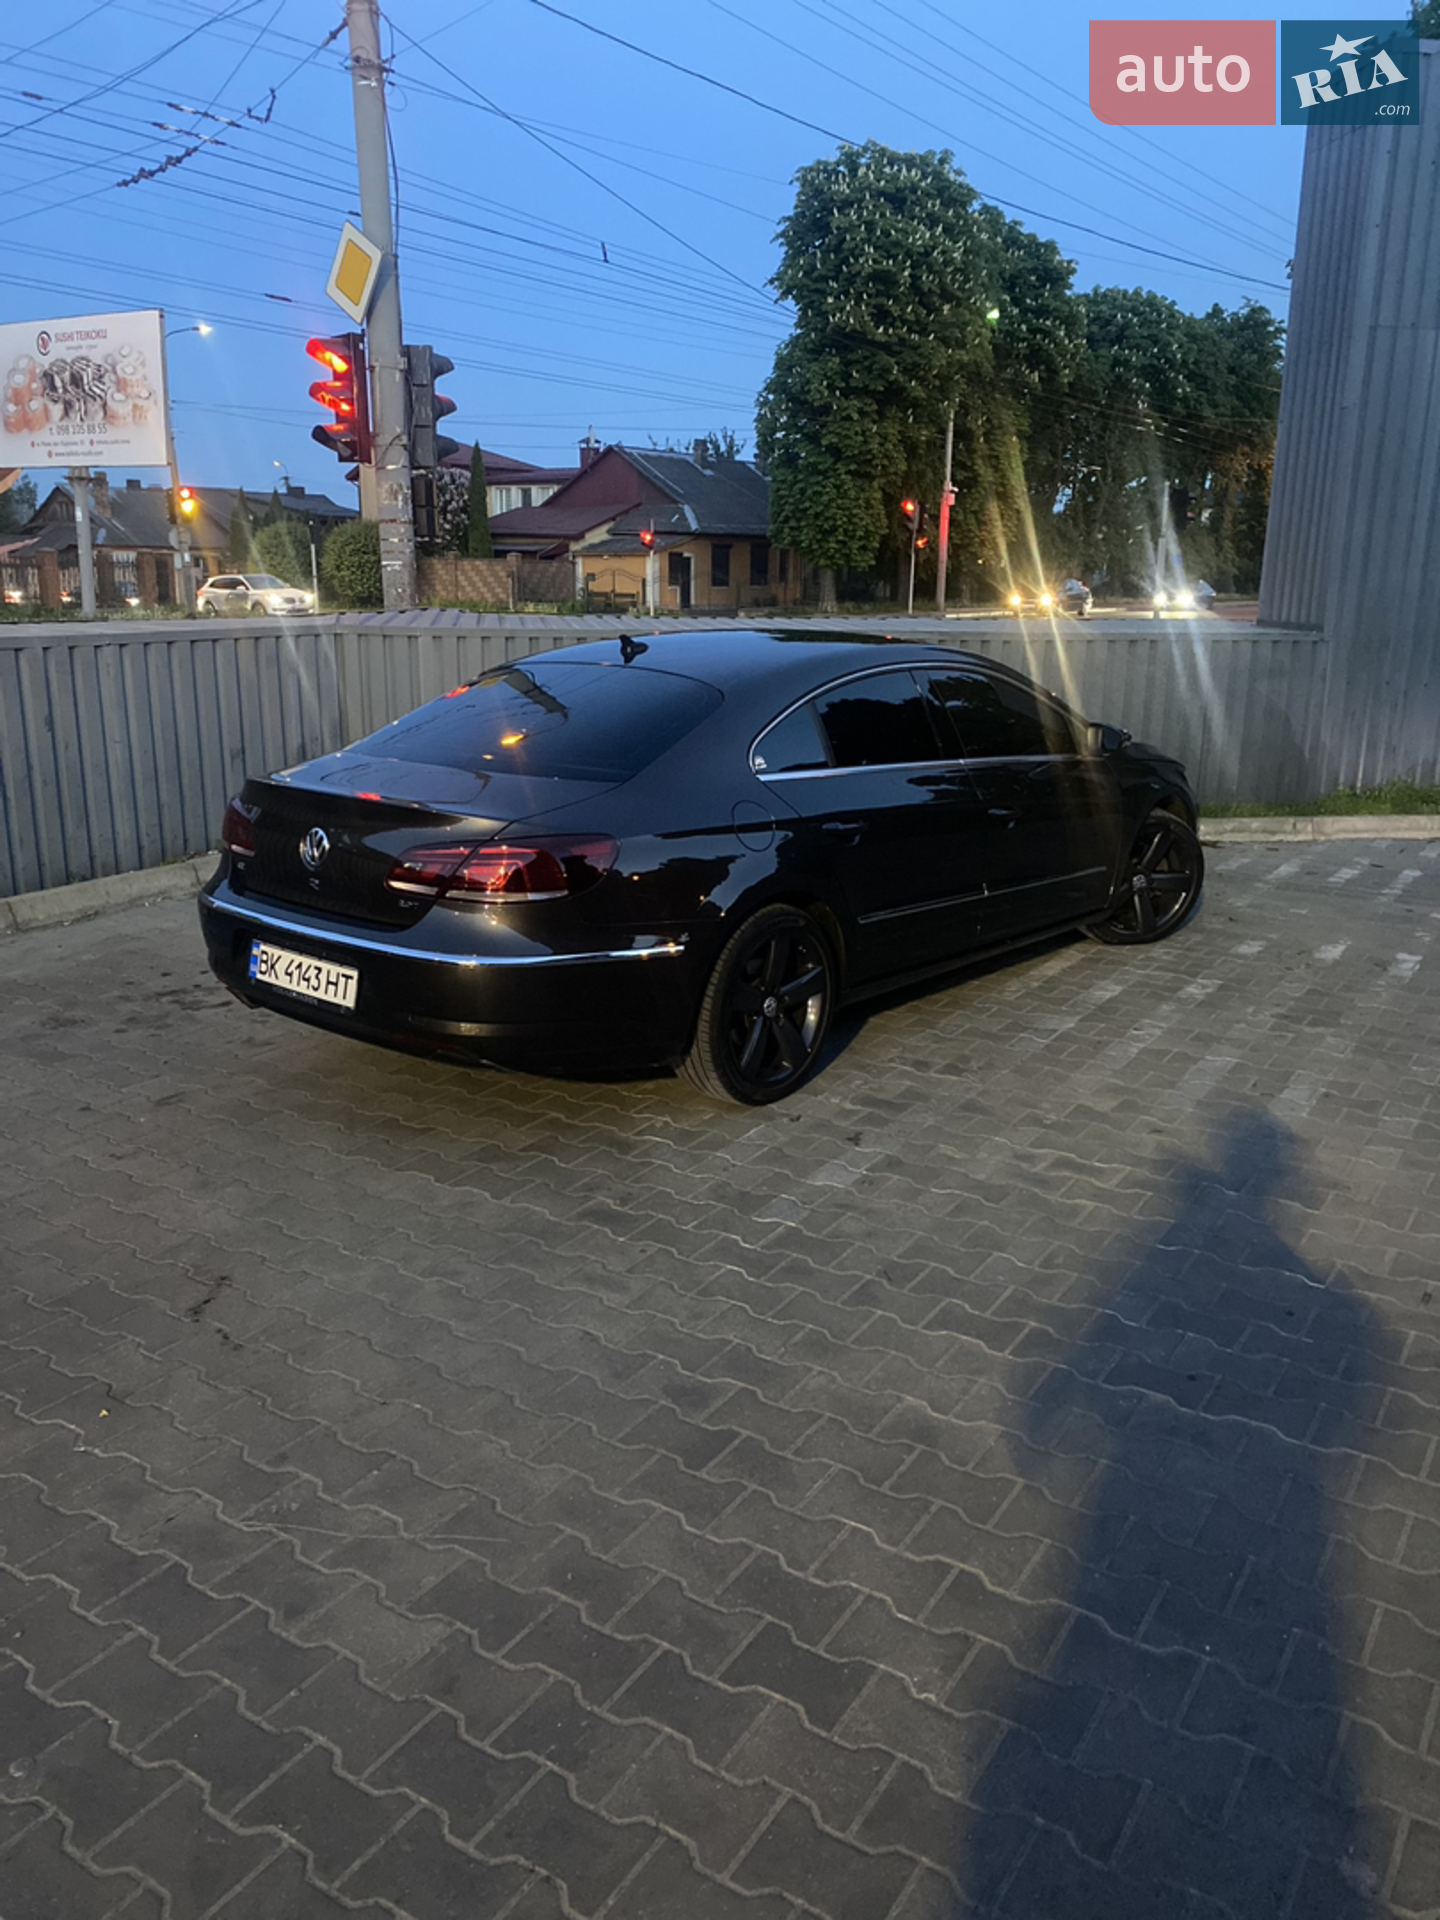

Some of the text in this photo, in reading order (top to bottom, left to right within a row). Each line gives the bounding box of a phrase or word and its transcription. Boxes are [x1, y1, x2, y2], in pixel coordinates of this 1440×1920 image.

[54, 329, 107, 342] SUSHI TEIKOKU
[97, 422, 108, 434] 55
[258, 950, 282, 980] BK
[284, 959, 323, 992] 4143
[324, 969, 355, 1000] HT
